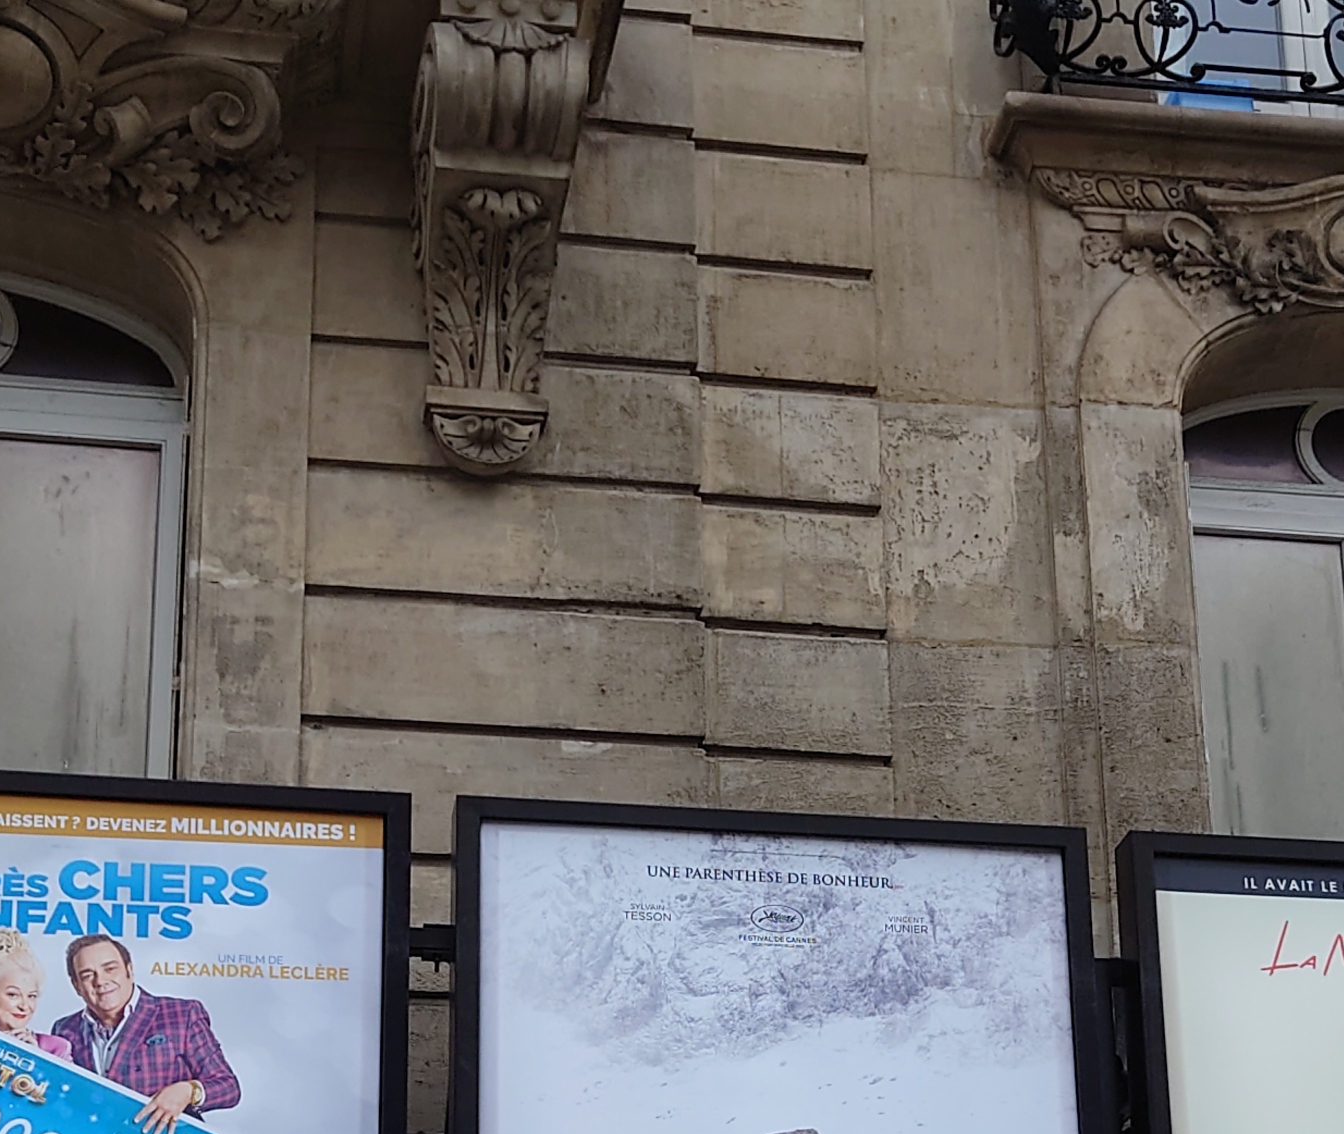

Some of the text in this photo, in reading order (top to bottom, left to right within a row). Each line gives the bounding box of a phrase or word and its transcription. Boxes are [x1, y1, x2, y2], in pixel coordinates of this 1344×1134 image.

[86, 817, 167, 833] DEVENEZ
[171, 817, 344, 840] MILLIONNAIRES
[647, 865, 680, 879] UNE
[685, 867, 782, 884] PARENTHÈSE
[787, 872, 807, 885] DE
[58, 859, 269, 906] CHERS
[1244, 877, 1258, 890] IL
[1264, 879, 1314, 892] AVAIT
[1321, 880, 1338, 893] LE
[630, 903, 665, 911] SYLVAIN
[624, 911, 672, 922] TESSON
[887, 915, 925, 924] VINCENT
[884, 924, 929, 934] MUNIER
[739, 934, 773, 942] FESTIVAL
[786, 936, 817, 944] CANNES
[218, 953, 284, 965] UN FILM DE
[151, 961, 349, 981] ALEXANDRA LECLÈRE
